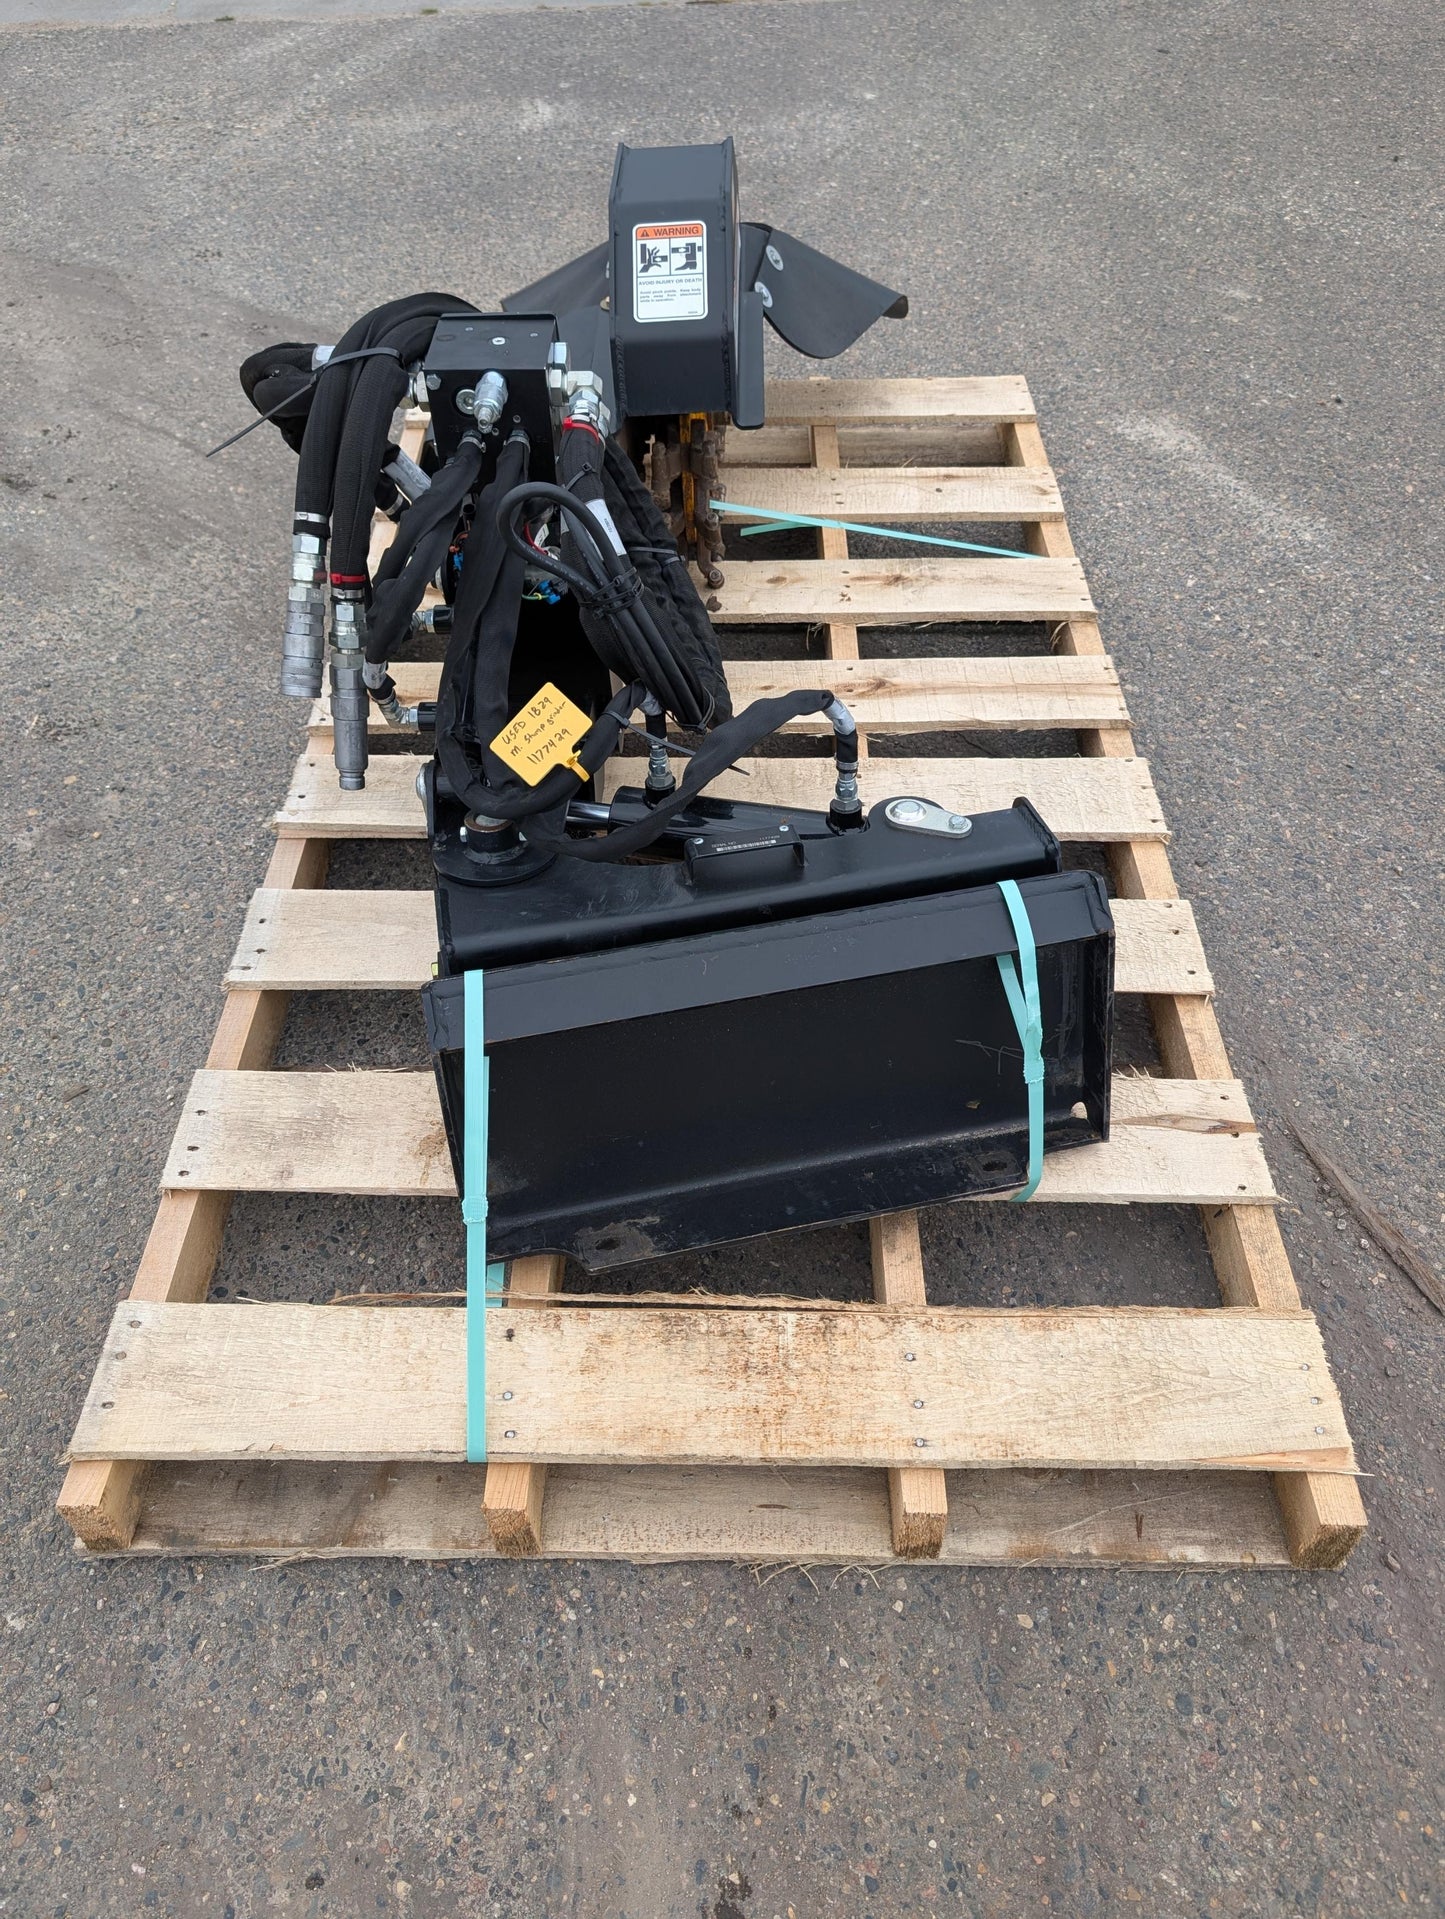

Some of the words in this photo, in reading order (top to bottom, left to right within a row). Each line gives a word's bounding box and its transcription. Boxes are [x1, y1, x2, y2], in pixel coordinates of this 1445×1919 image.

[653, 226, 699, 237] WARNING
[502, 720, 526, 745] USED
[527, 696, 553, 719] 1829
